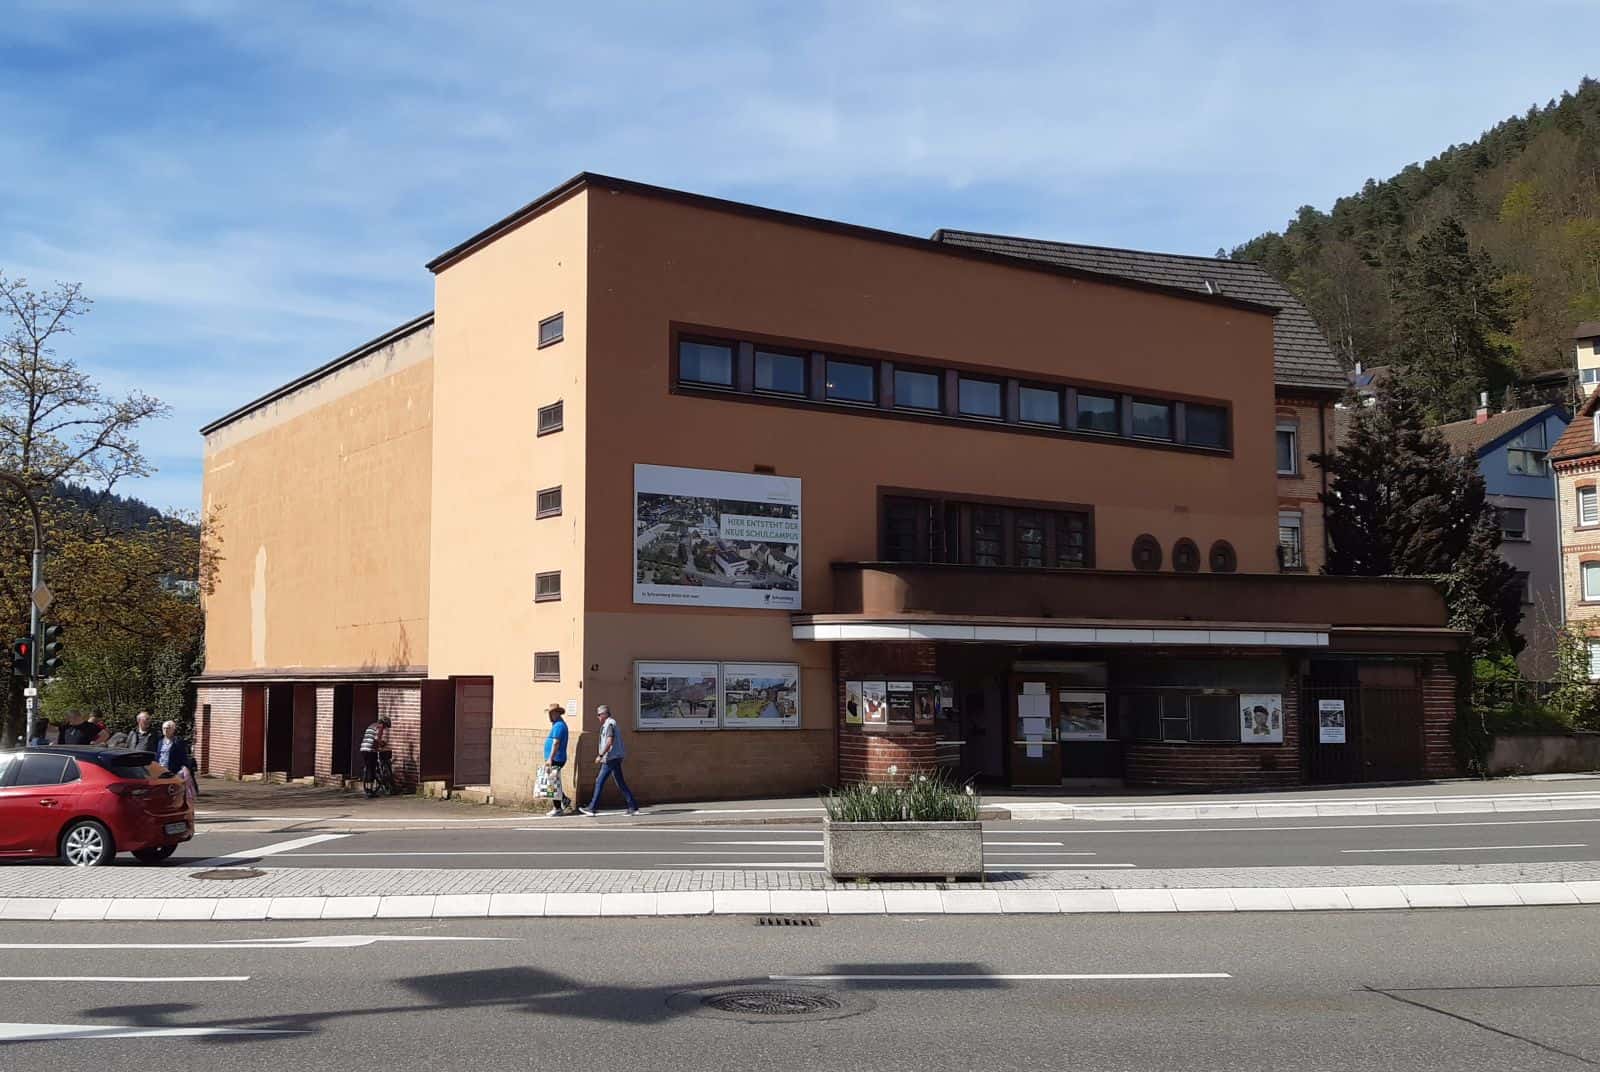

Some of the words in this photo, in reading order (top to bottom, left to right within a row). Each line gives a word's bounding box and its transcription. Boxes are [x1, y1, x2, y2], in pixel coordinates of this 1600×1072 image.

[728, 518, 745, 527] HIER
[746, 519, 784, 529] ENTSTEHT
[785, 521, 798, 530] DER
[725, 528, 744, 537] NEUE
[745, 529, 799, 540] SCHULCAMPUS
